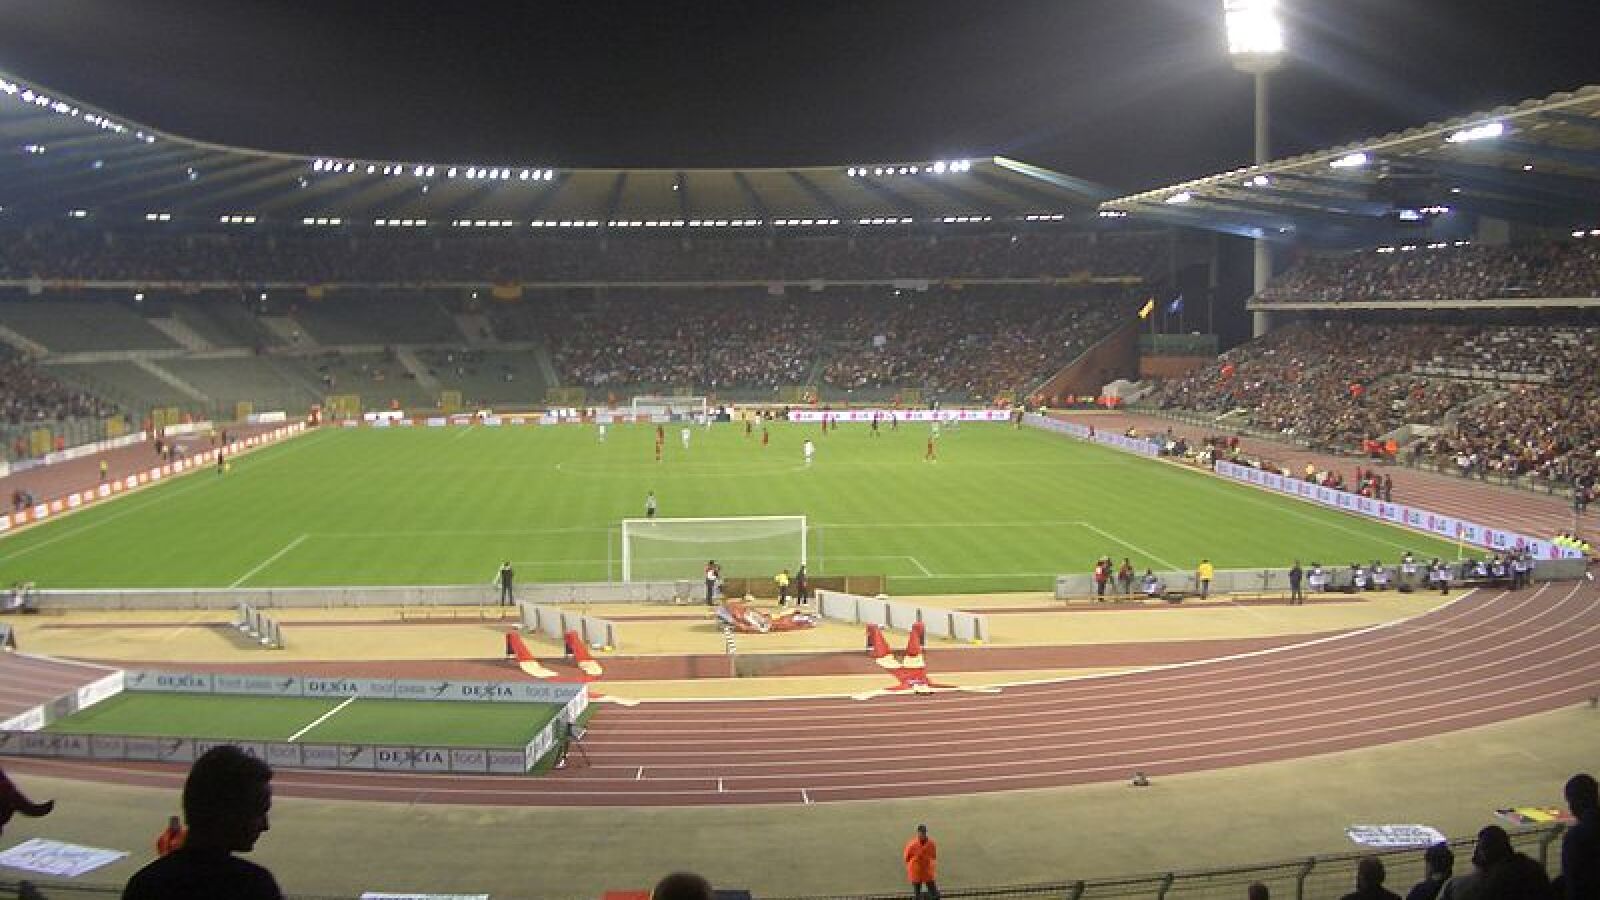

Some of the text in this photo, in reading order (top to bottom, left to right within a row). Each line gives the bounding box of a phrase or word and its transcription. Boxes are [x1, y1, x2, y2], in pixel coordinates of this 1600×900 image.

[309, 681, 357, 693] DEXIA
[462, 684, 512, 696] DEXIA
[379, 750, 442, 763] DEXIA
